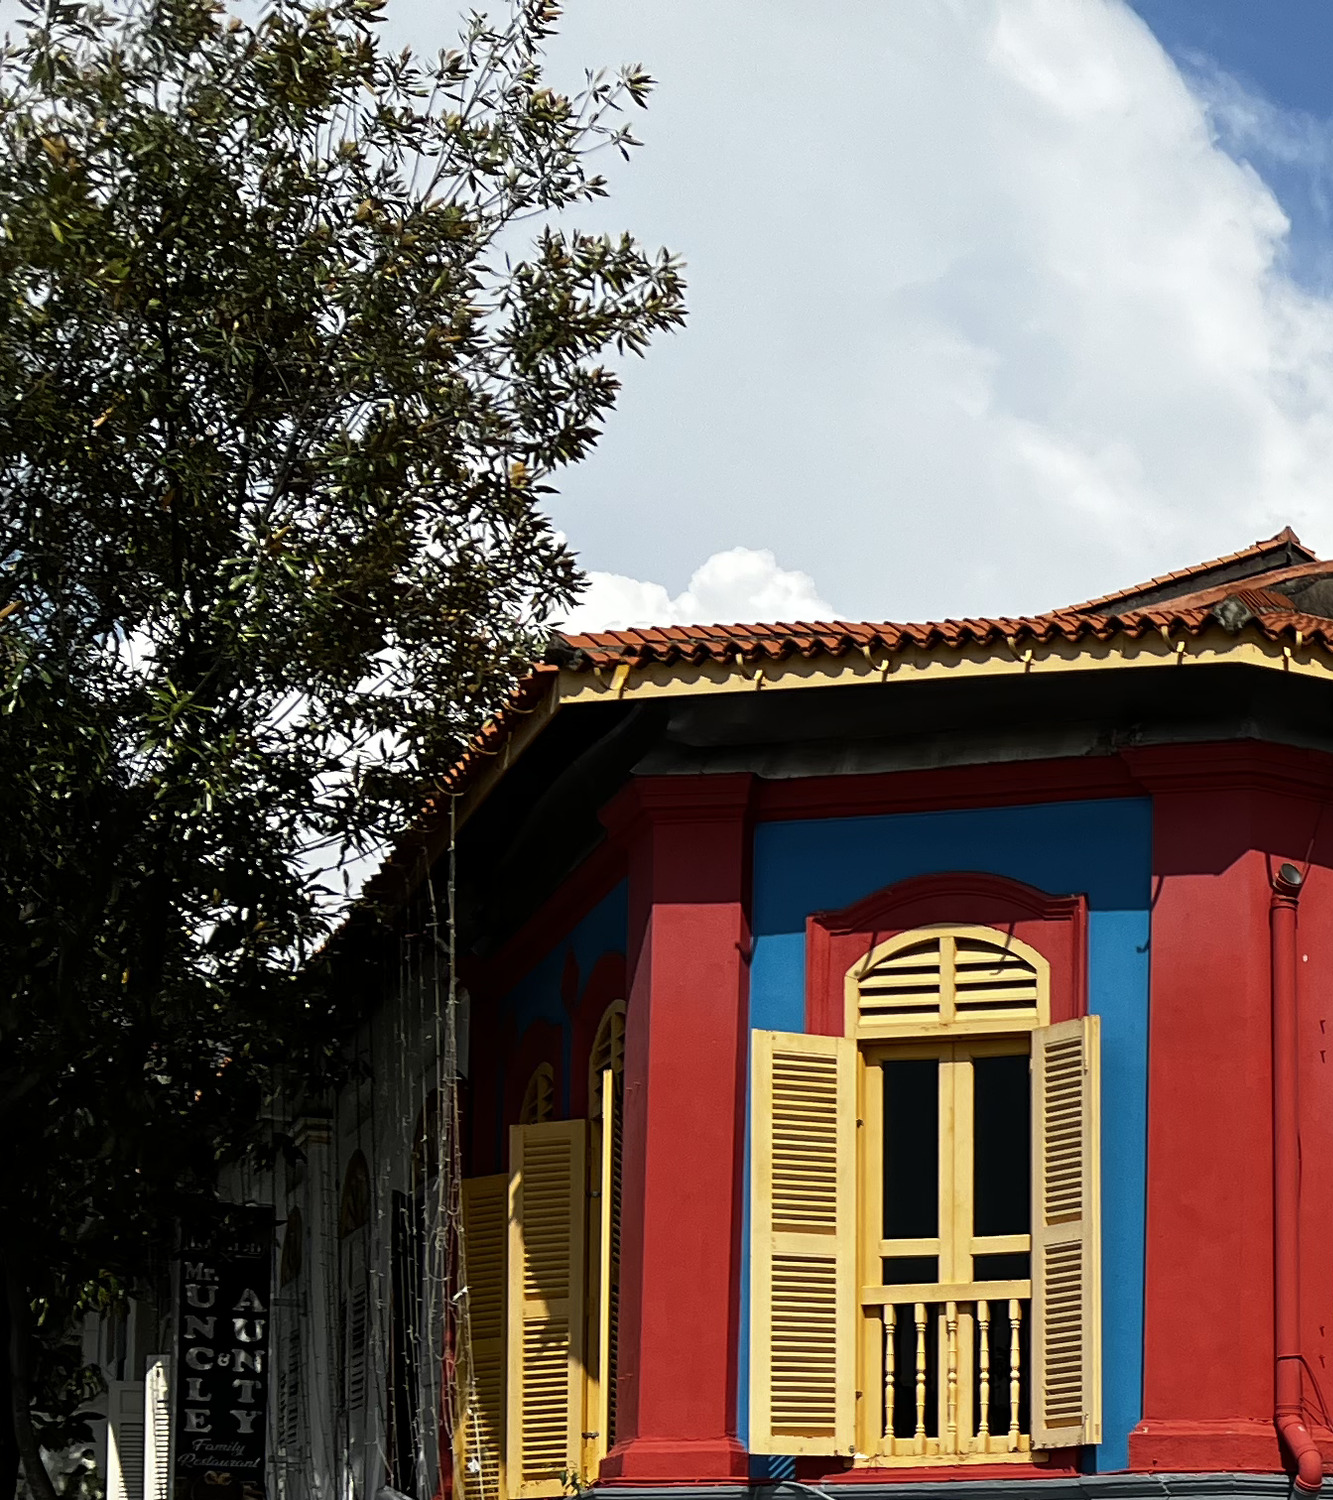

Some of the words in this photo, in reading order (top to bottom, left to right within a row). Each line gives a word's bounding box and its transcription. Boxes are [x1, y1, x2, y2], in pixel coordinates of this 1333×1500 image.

[184, 1262, 220, 1281] Mr.
[183, 1284, 219, 1433] UNCLE
[217, 1353, 230, 1367] &
[230, 1287, 268, 1434] AUNTY
[191, 1437, 247, 1457] Family
[177, 1453, 261, 1469] Restaurant
